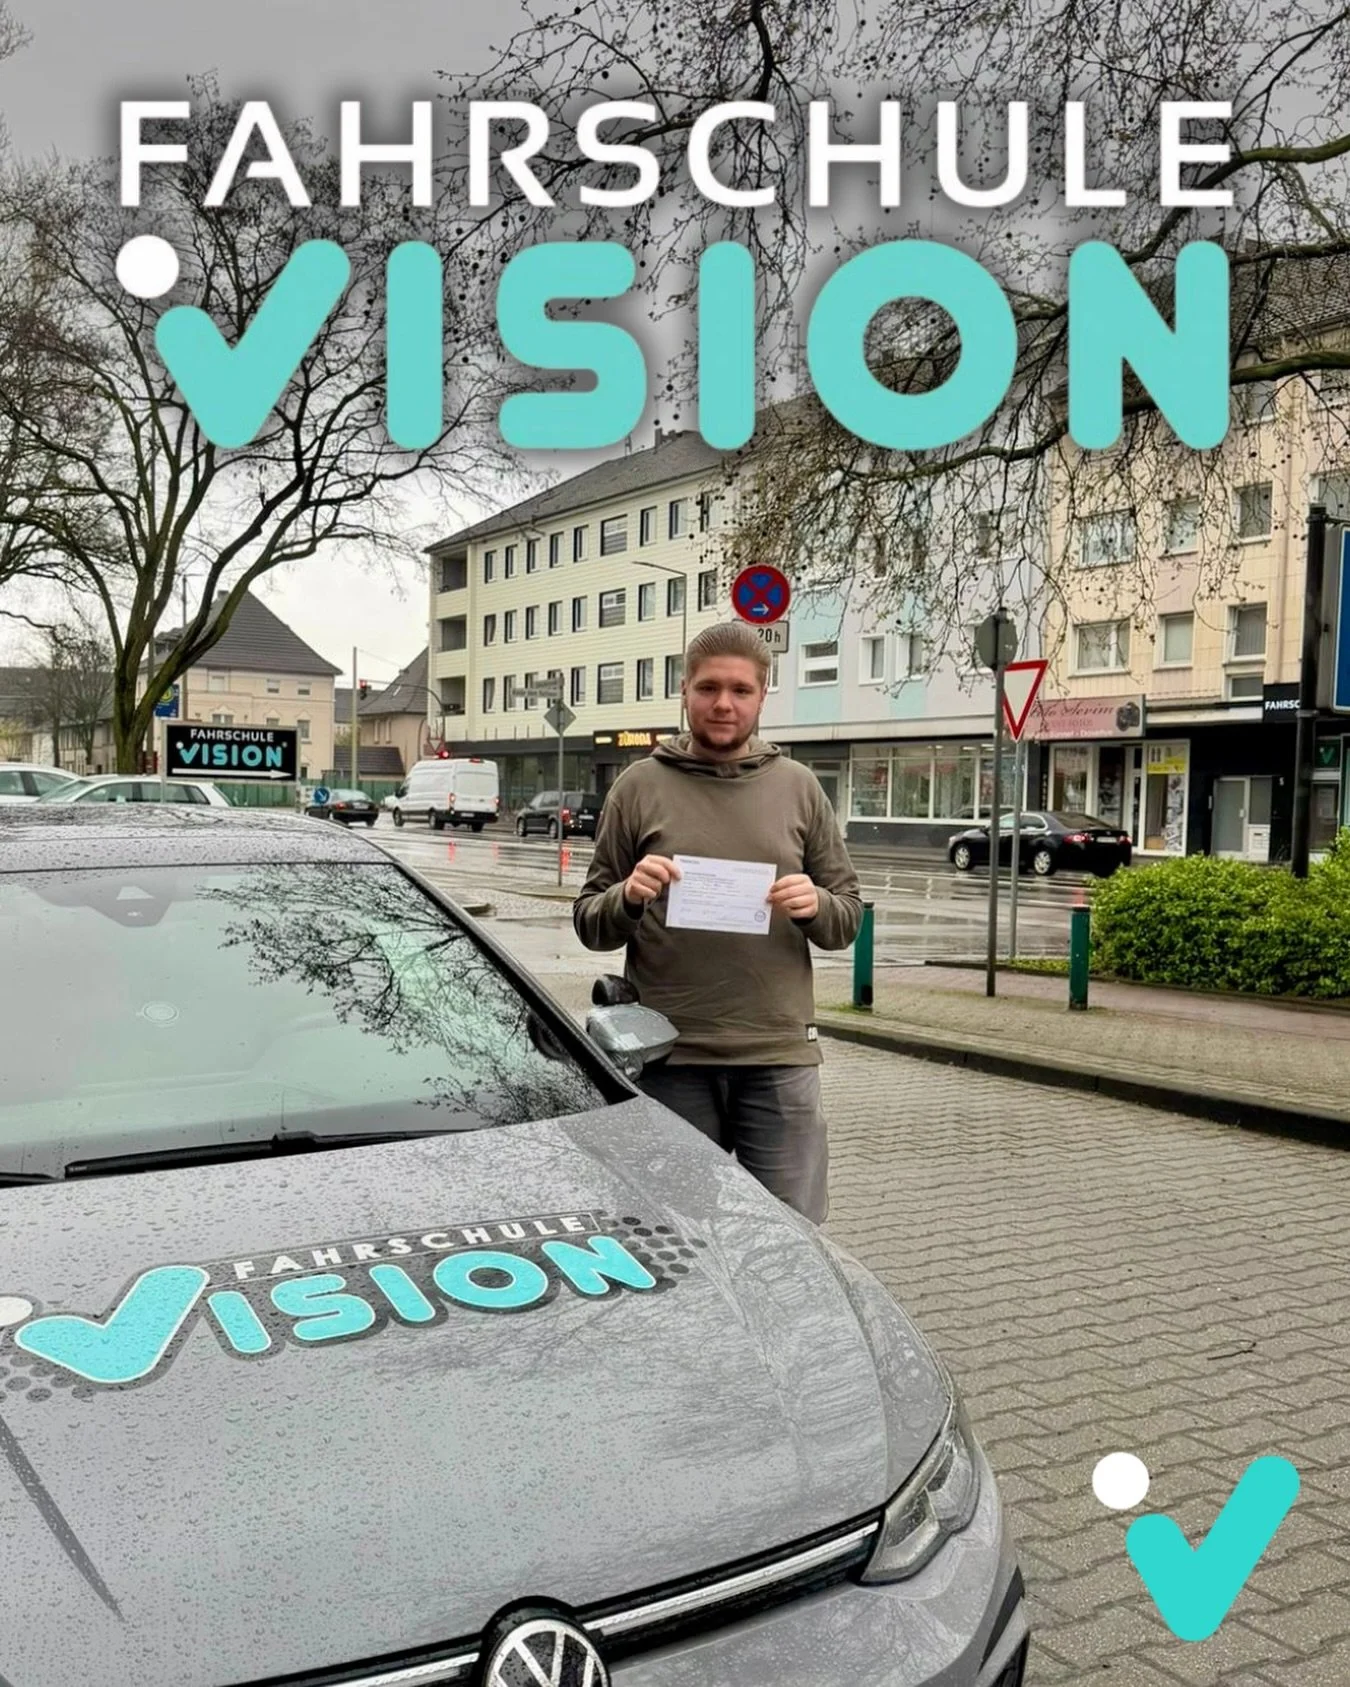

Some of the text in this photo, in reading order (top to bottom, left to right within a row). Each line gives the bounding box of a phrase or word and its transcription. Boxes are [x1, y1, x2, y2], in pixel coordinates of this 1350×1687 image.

[180, 744, 282, 767] VISION
[190, 728, 274, 743] FAHRSCHULE
[234, 1217, 585, 1280] FAHRSCHULE
[14, 1236, 657, 1384] VISION
